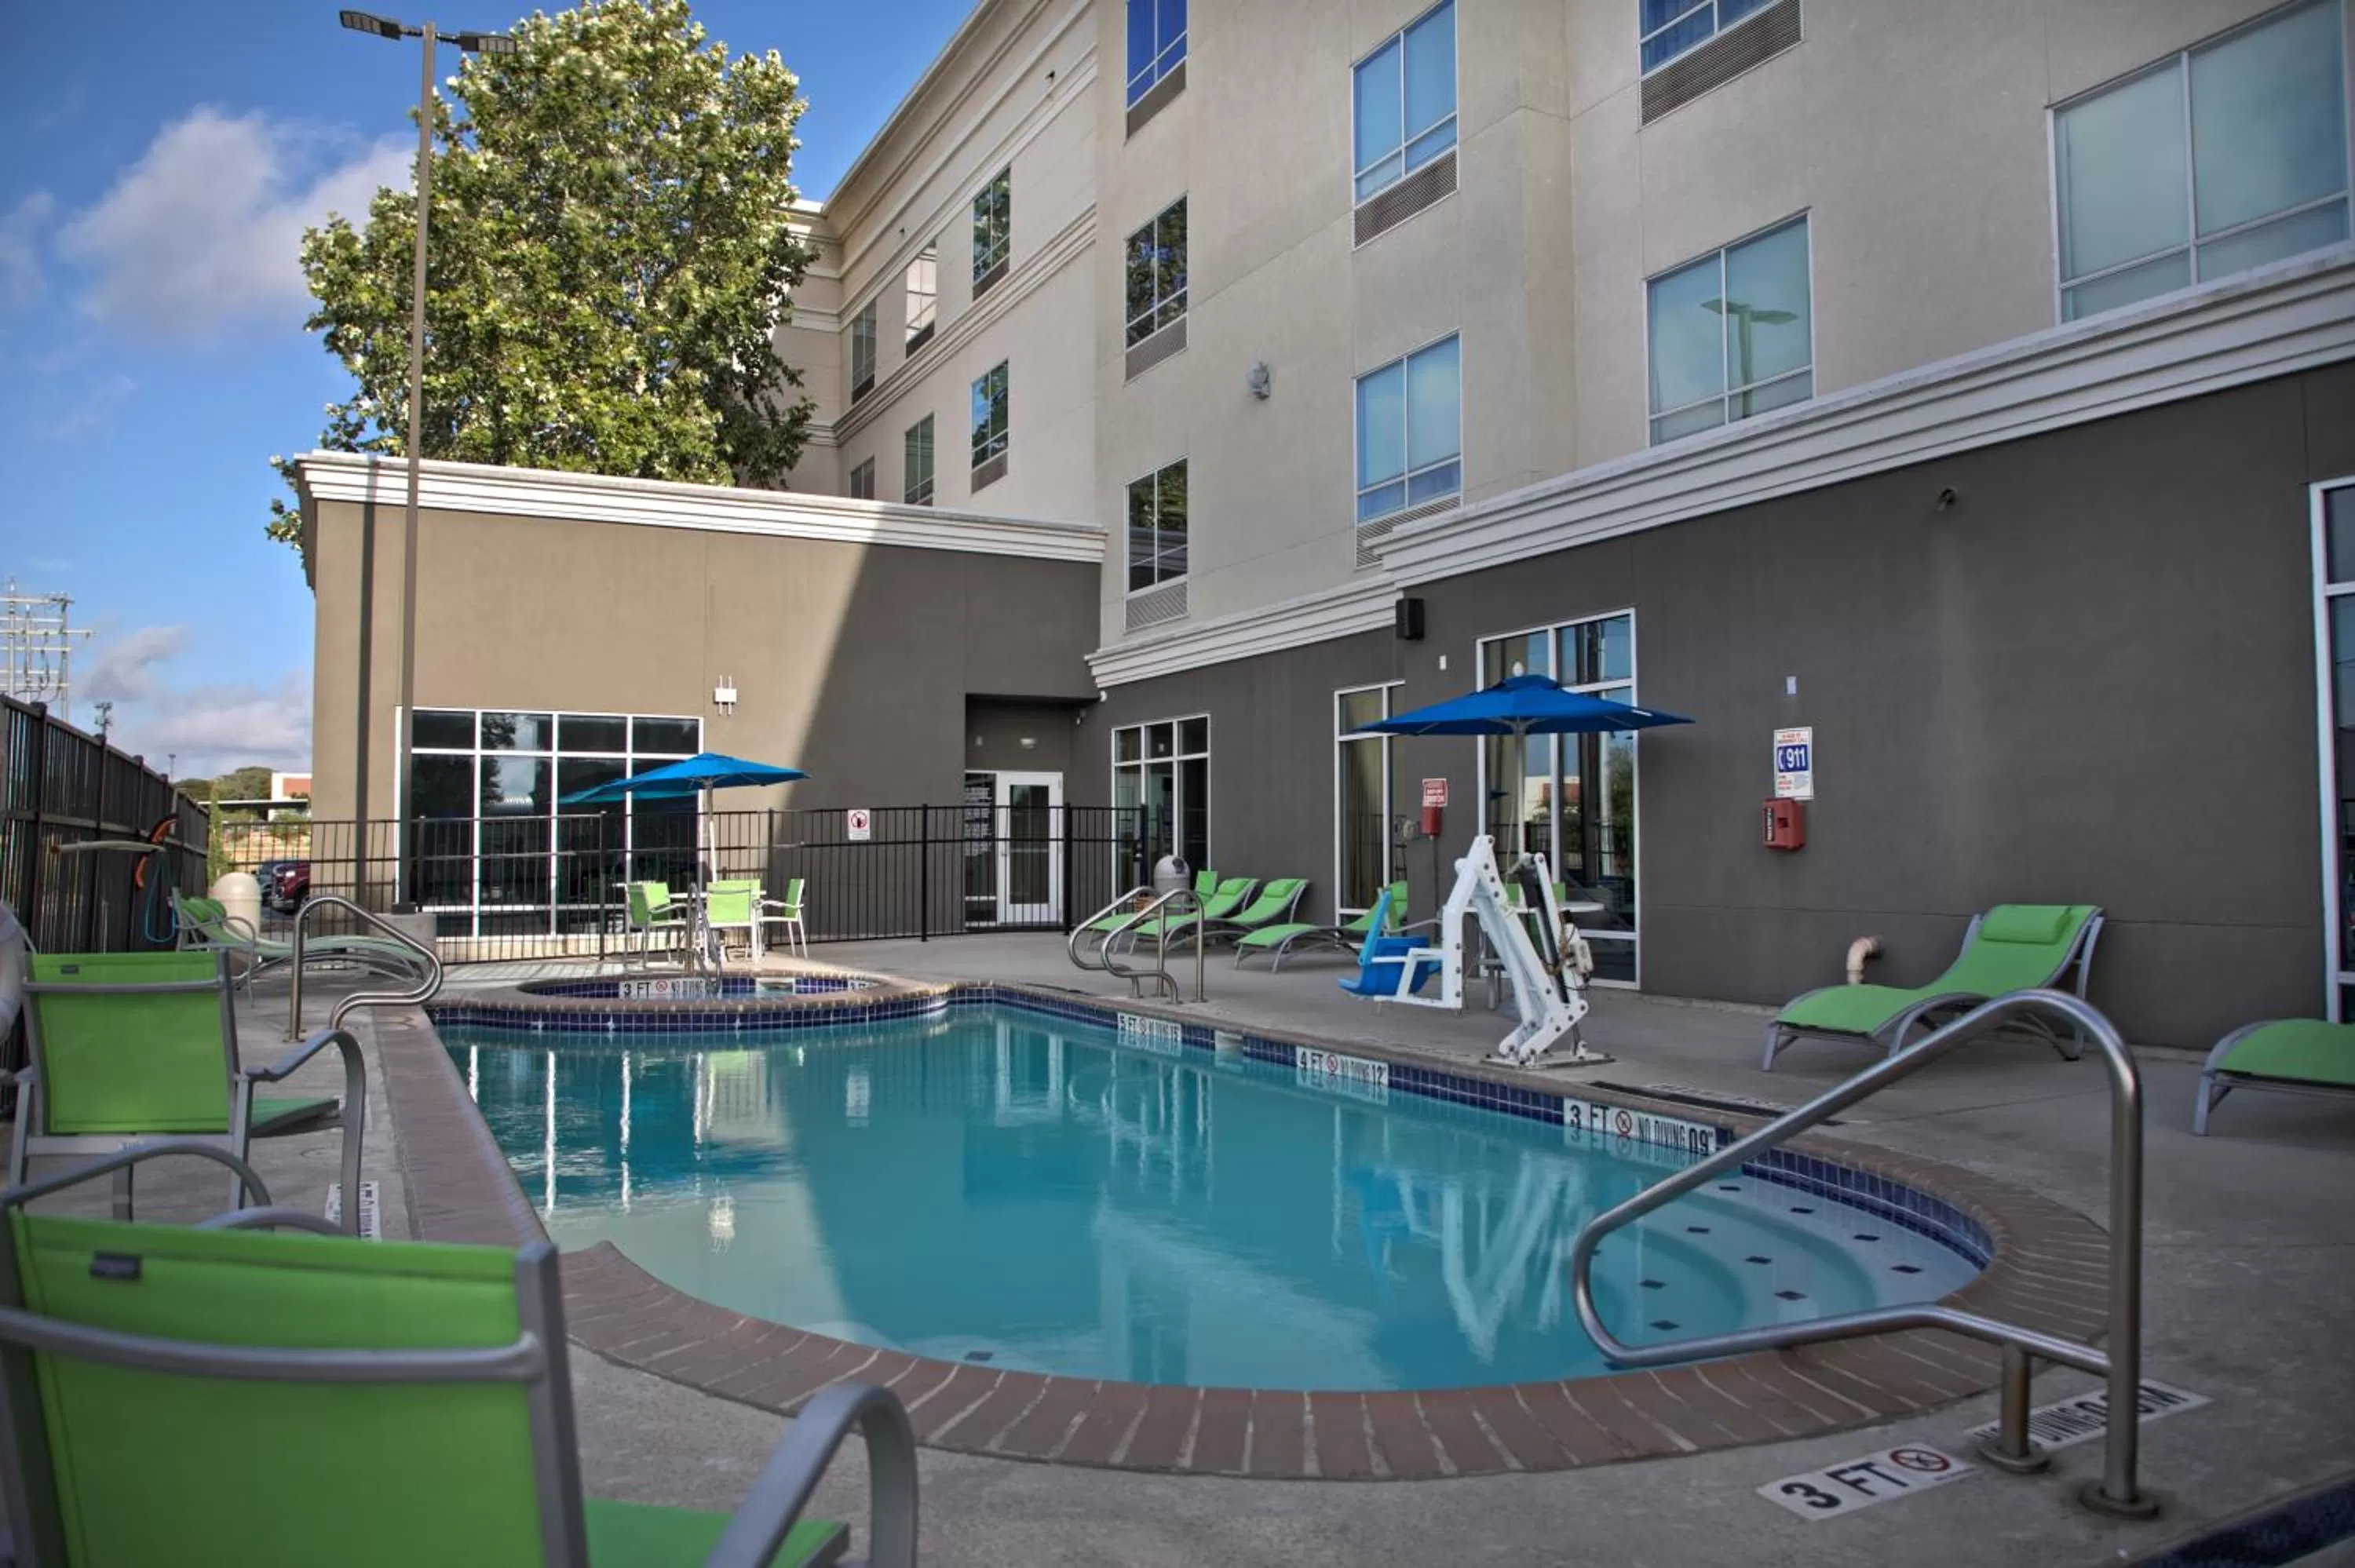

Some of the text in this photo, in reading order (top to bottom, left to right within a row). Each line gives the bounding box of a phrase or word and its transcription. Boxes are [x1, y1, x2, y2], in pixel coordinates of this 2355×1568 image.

[1786, 746, 1806, 768] 911
[623, 983, 632, 997] 3
[636, 983, 651, 1001] FT
[1311, 1053, 1323, 1073] FT
[1571, 1104, 1581, 1129] 3
[1590, 1104, 1609, 1132] FT
[1638, 1117, 1649, 1142] NO
[1655, 1120, 1685, 1148] DIVING
[1780, 1461, 1908, 1510] 3 FT
